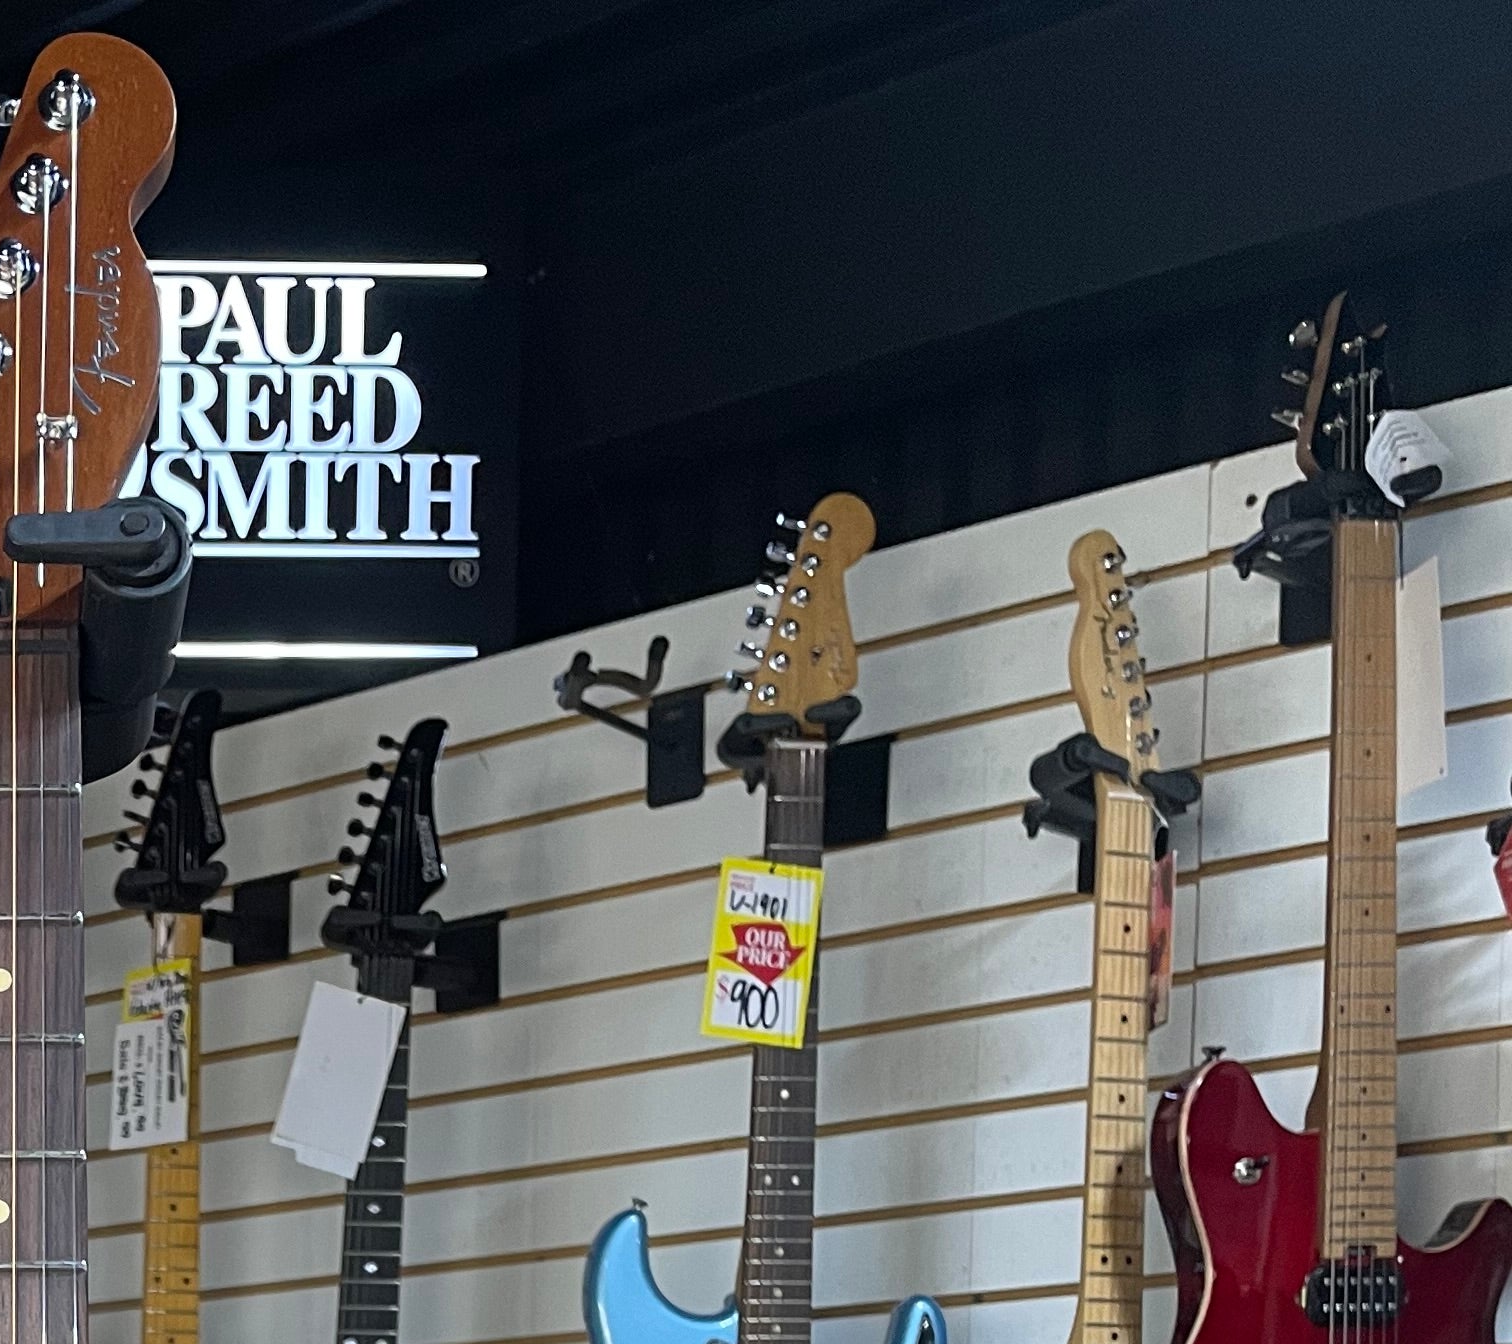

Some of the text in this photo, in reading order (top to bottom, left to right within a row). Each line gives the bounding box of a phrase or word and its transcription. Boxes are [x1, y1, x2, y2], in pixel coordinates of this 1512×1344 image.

[65, 246, 136, 416] Fender
[153, 275, 402, 366] PAUL
[151, 365, 422, 452] REED
[151, 452, 481, 540] SMITH
[737, 946, 792, 970] PRICE
[744, 926, 787, 950] OUR
